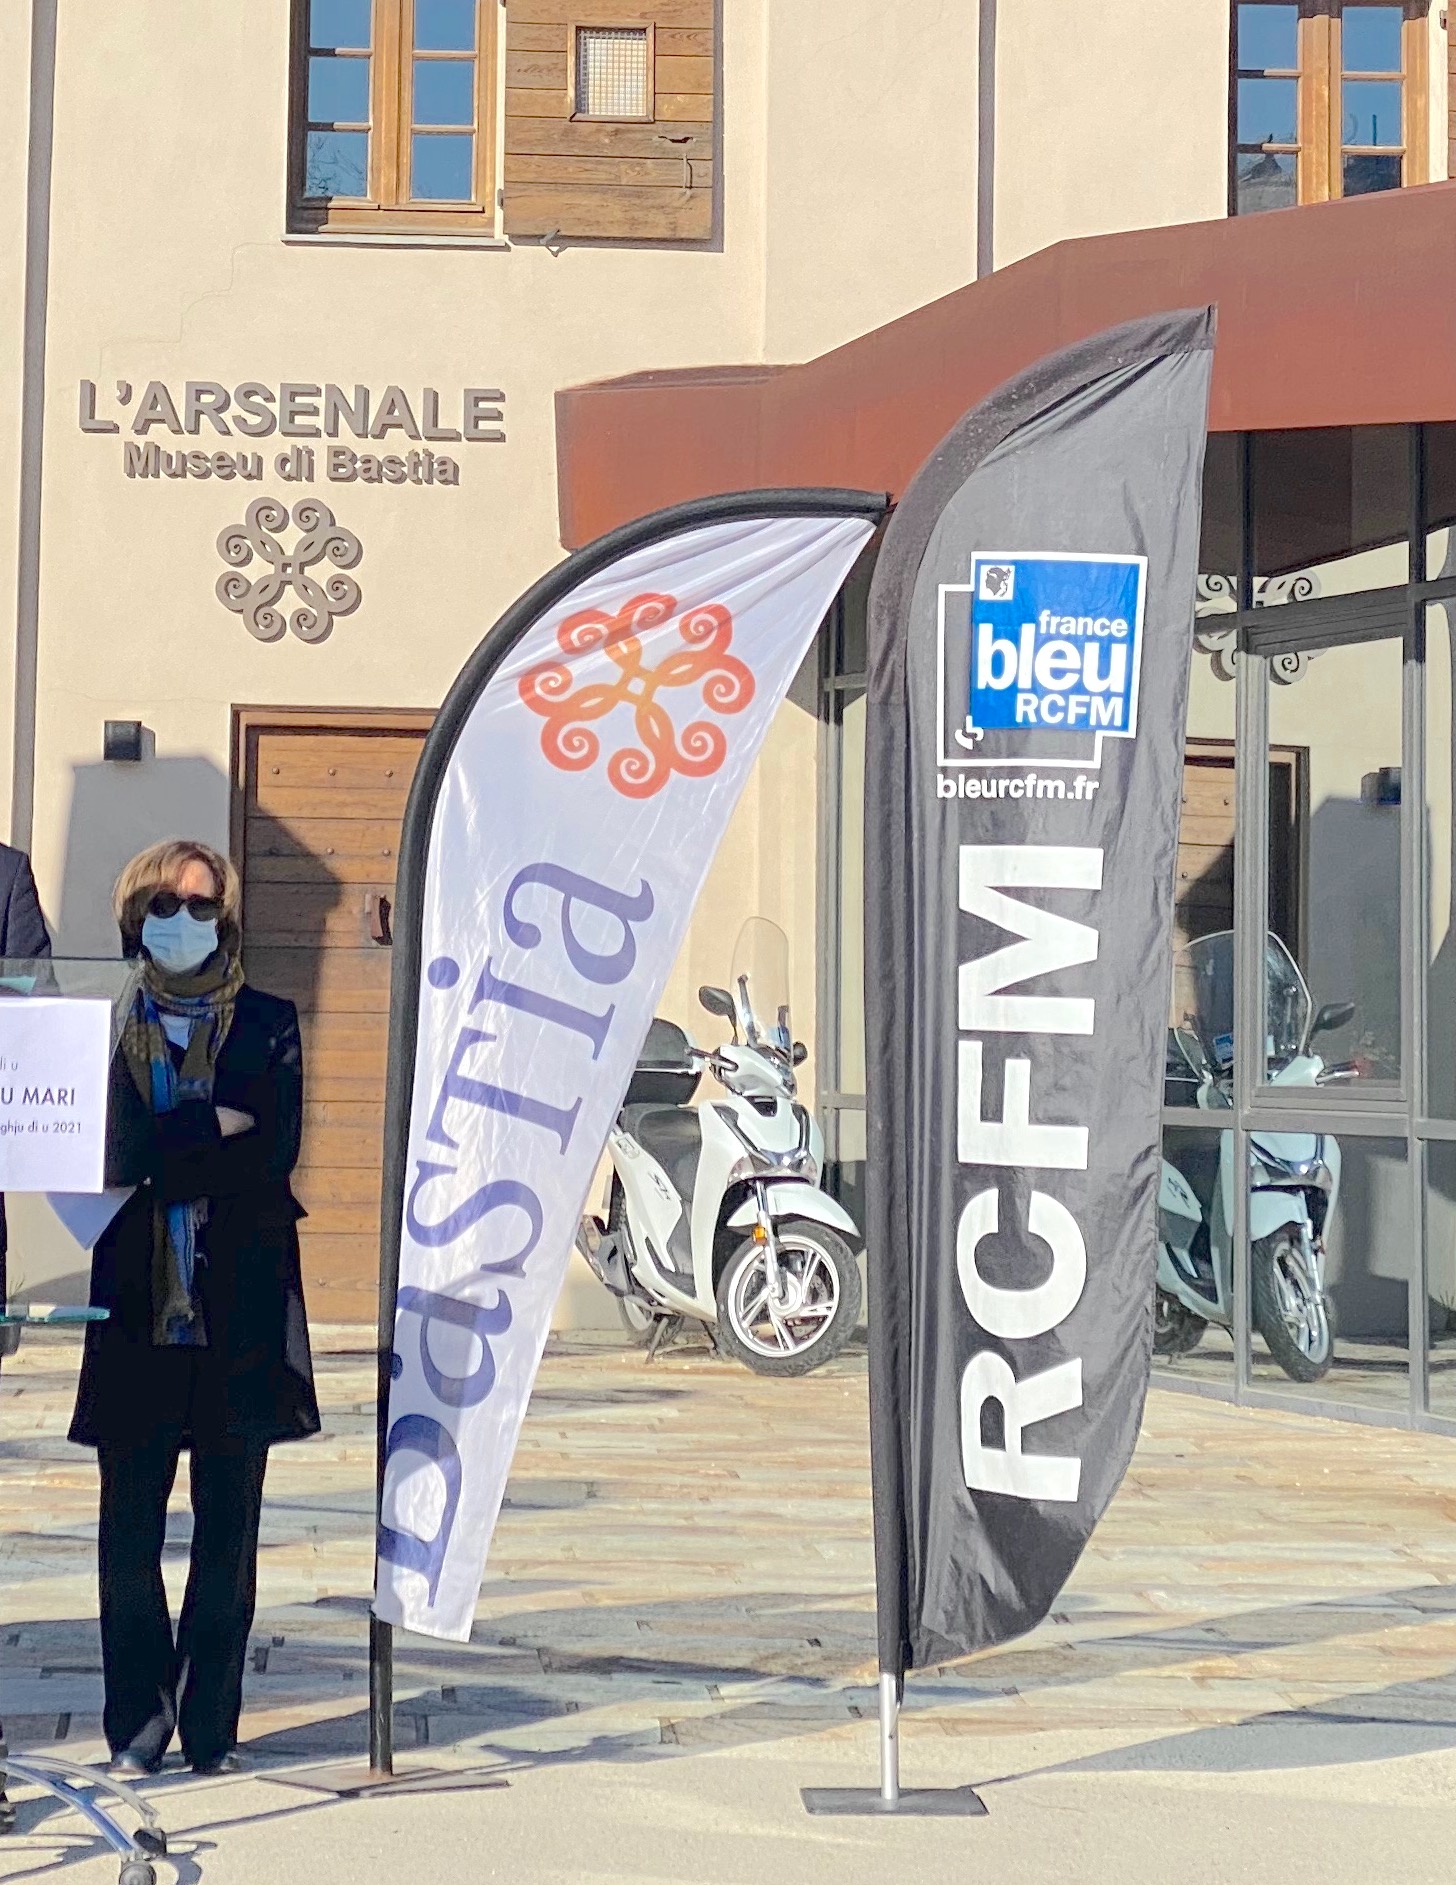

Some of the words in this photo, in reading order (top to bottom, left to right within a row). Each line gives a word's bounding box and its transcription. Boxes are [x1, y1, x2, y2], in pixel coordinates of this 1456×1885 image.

[79, 378, 506, 442] L'ARSENALE
[124, 441, 263, 480] Museu
[274, 444, 314, 482] di
[327, 445, 460, 486] Bastia
[1038, 609, 1129, 638] france
[977, 622, 1127, 693] bleu
[1015, 693, 1124, 727] RCFM
[936, 774, 1100, 800] bleurcfm.fr
[11, 1059, 19, 1072] u
[22, 1087, 76, 1106] MARI
[28, 1120, 38, 1133] di
[42, 1123, 49, 1133] u
[53, 1121, 82, 1134] 2021
[956, 844, 1104, 1502] RCFM
